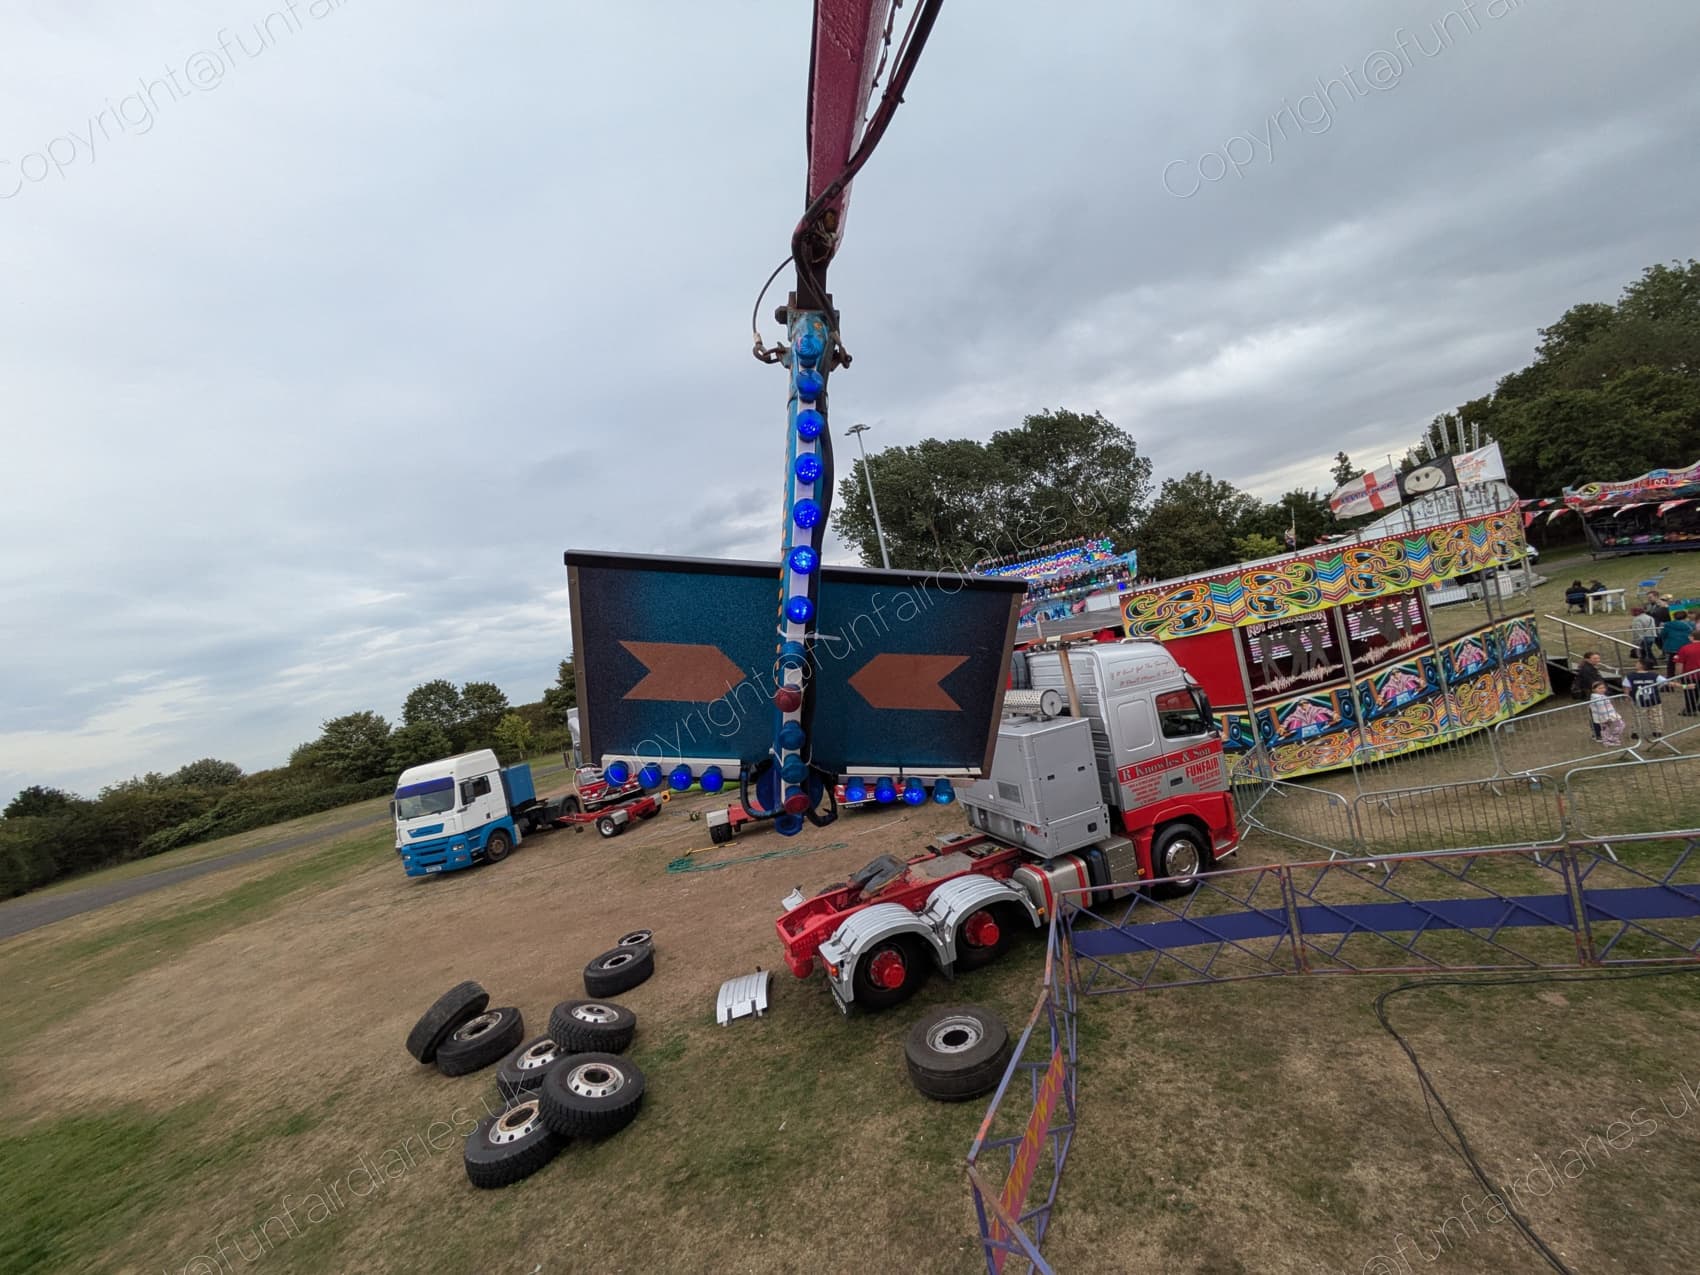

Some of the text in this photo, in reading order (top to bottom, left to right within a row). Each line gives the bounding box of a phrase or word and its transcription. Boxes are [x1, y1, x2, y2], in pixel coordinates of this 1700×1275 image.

[1122, 746, 1211, 780] R Knowles & Son
[1185, 757, 1219, 778] FUNFAIR
